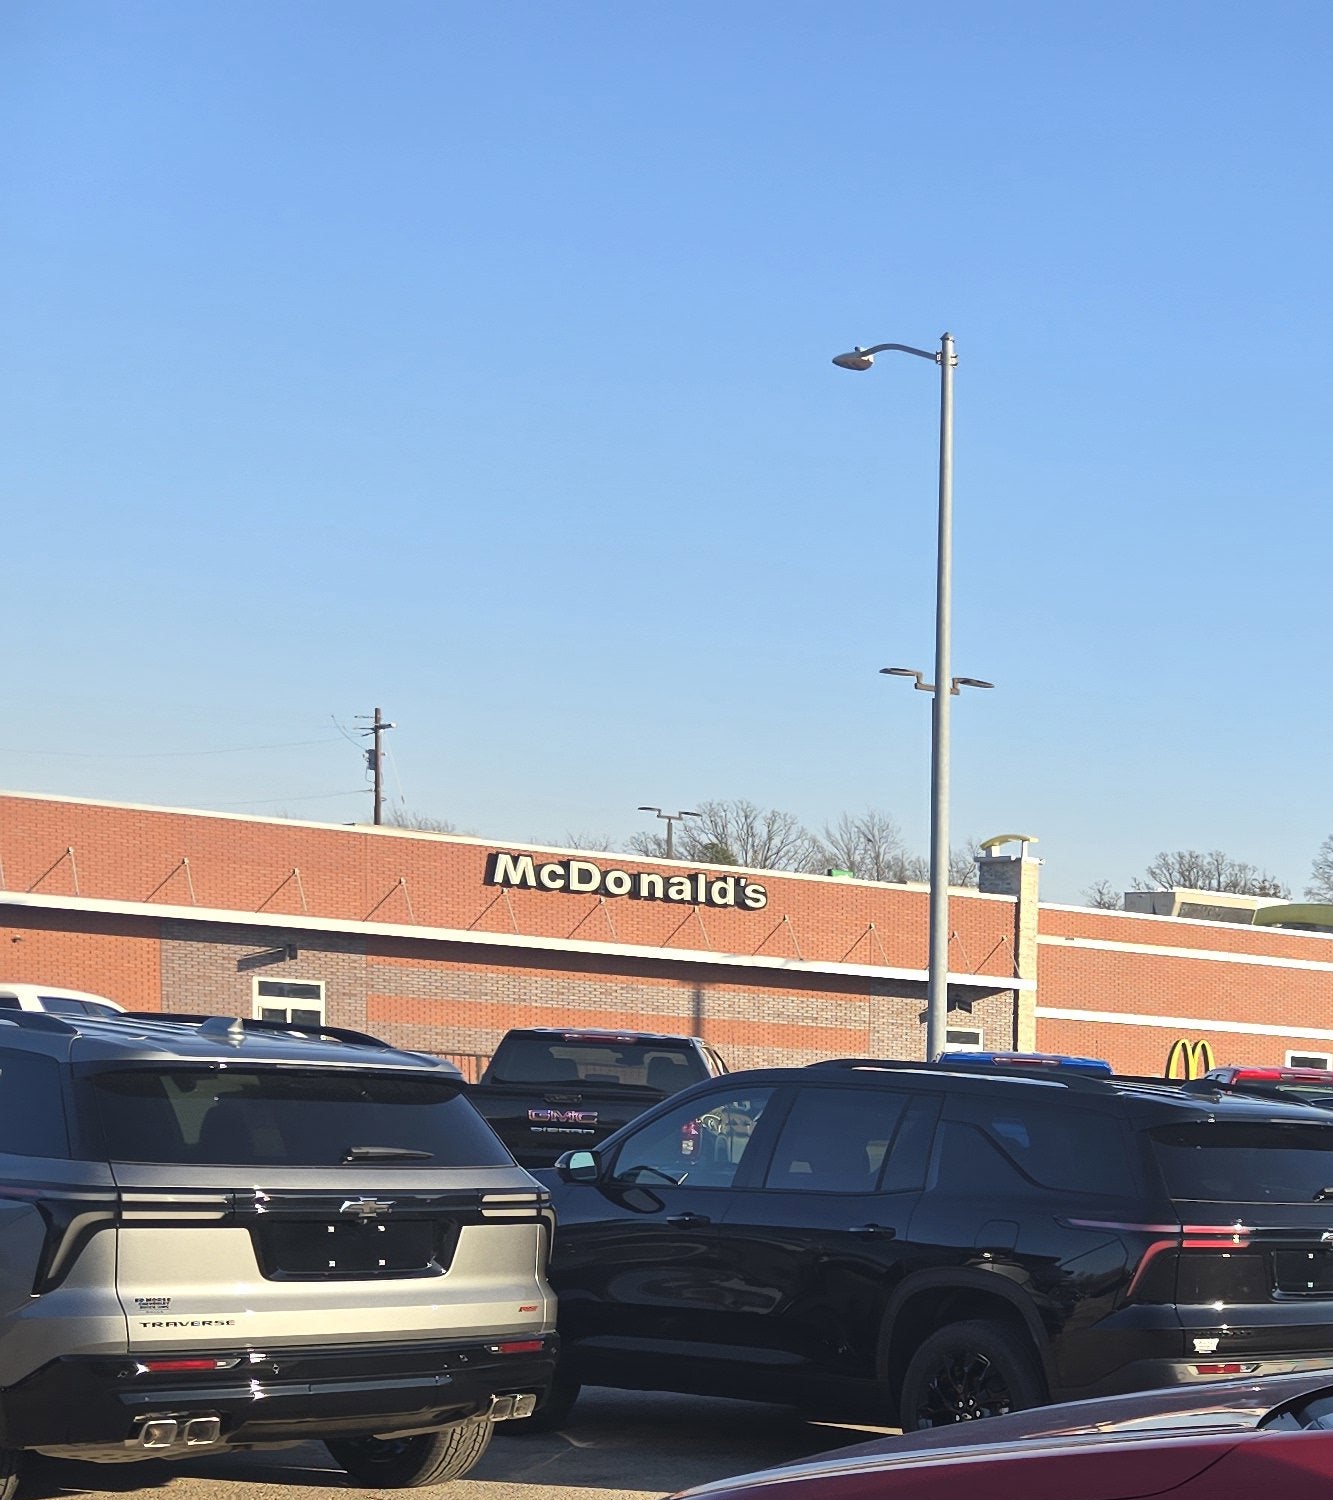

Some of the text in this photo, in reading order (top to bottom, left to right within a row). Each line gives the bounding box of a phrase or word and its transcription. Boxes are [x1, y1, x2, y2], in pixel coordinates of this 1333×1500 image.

[491, 852, 768, 910] McDonald's
[528, 1109, 598, 1124] GMC
[140, 1320, 235, 1328] TRAVERSE
